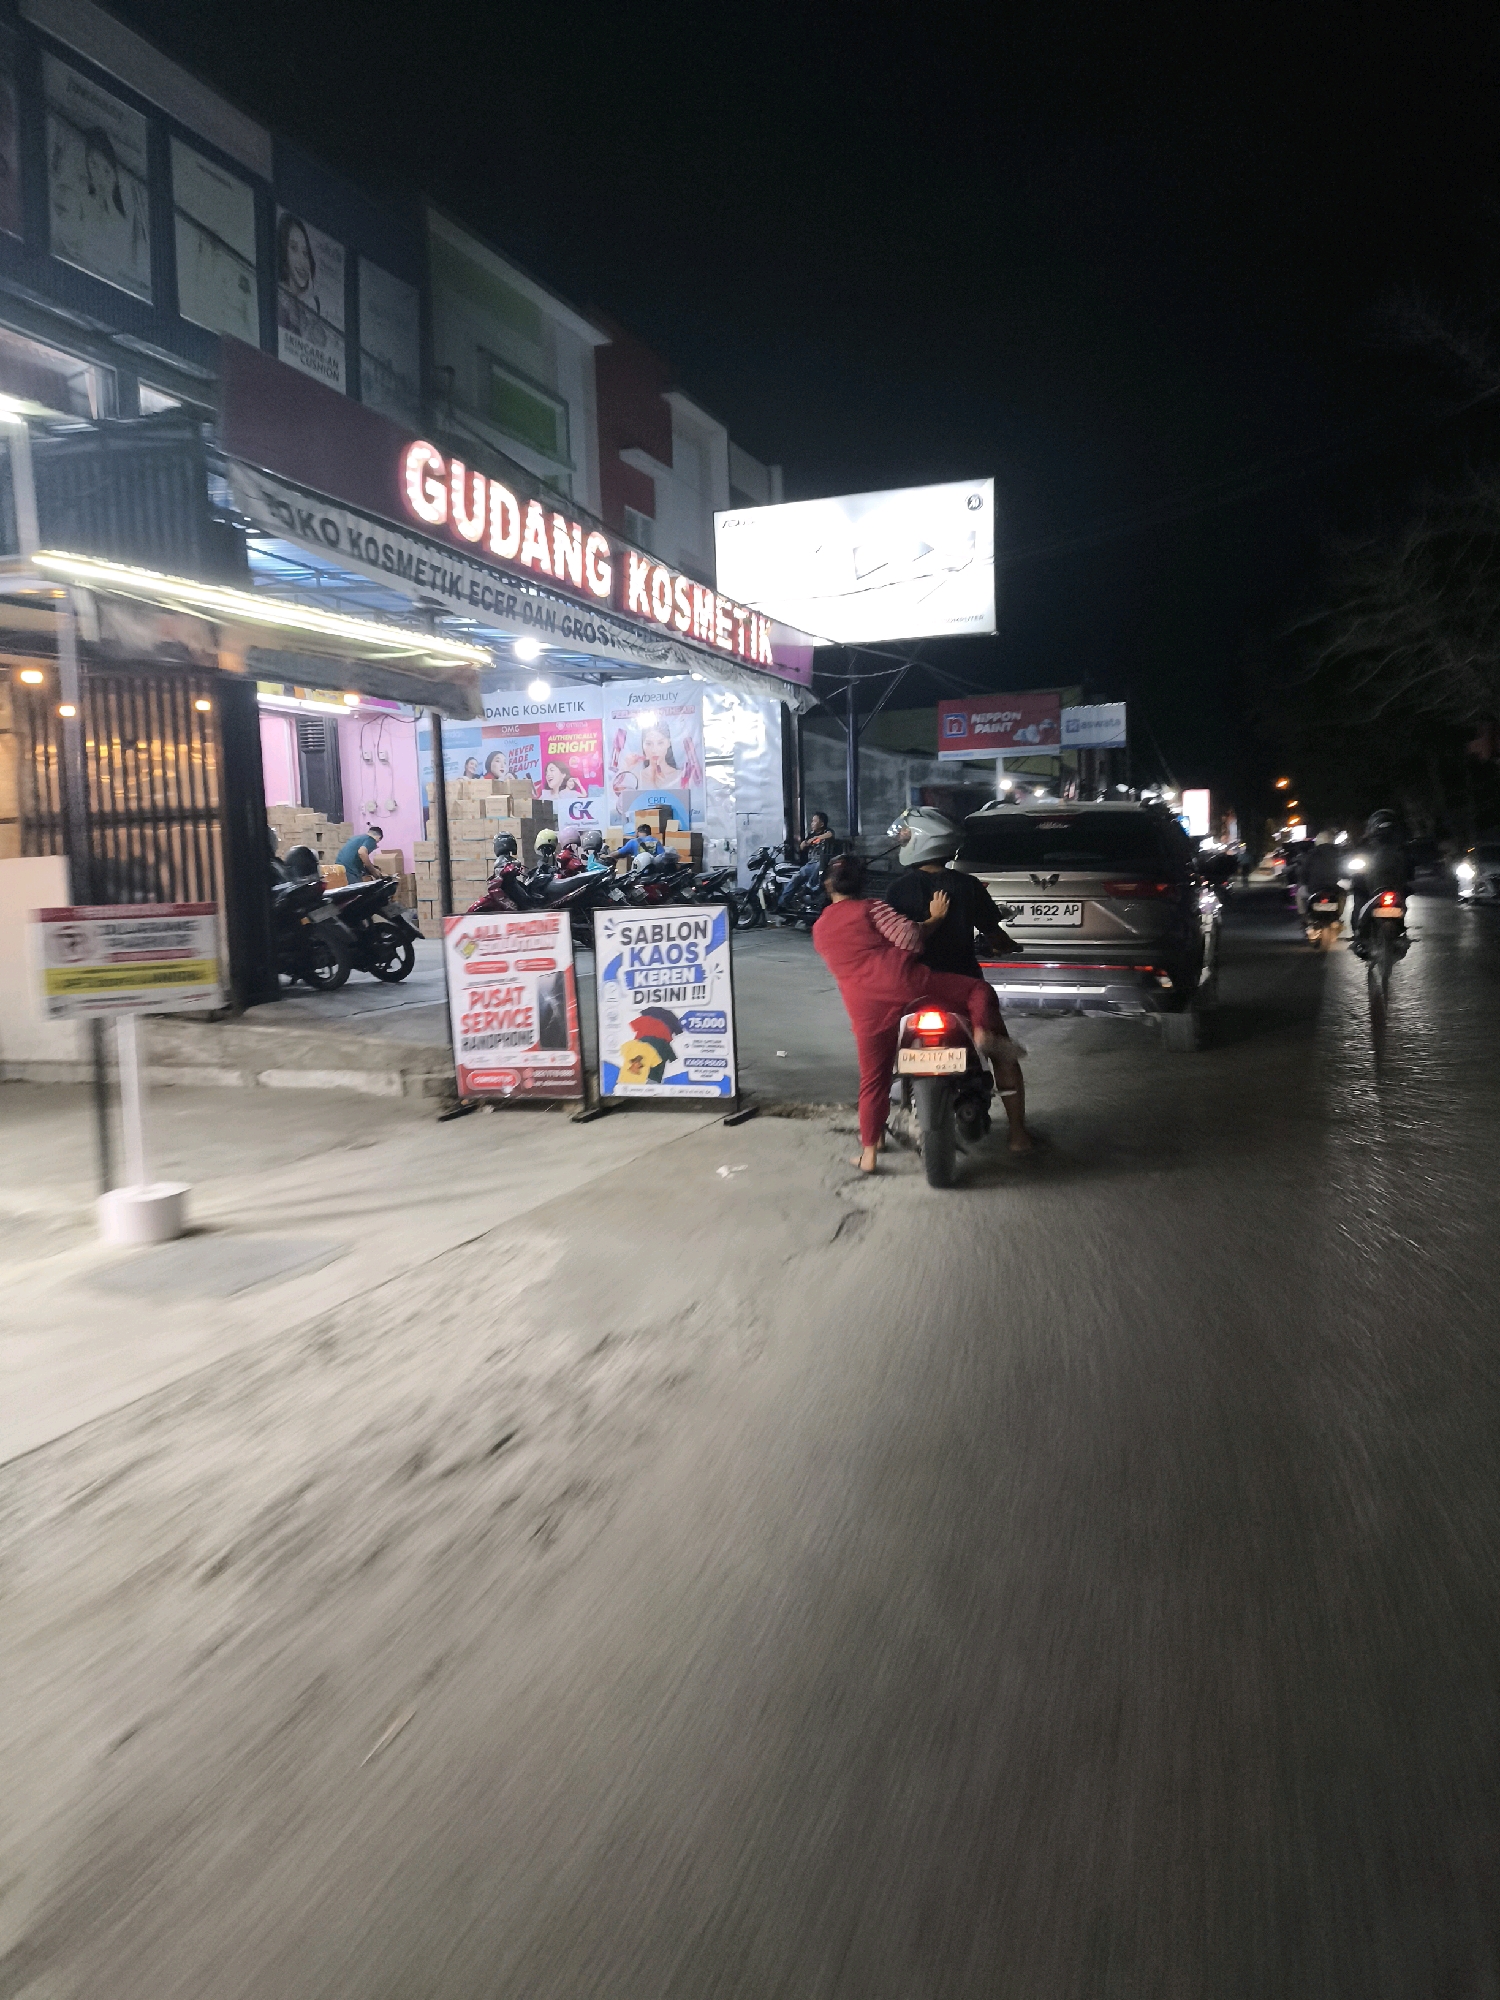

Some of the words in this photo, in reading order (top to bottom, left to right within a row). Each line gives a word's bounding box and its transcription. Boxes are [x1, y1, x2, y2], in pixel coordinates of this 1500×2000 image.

[403, 440, 612, 598] GUDANG
[626, 550, 774, 666] KOSMETIK
[264, 492, 341, 549] OKO
[347, 527, 462, 601] KOSMETIK
[468, 579, 518, 620] ECER
[522, 600, 557, 634] DAN
[627, 692, 679, 706] favbeauty
[486, 706, 519, 719] DANG
[523, 701, 586, 716] KOSMETIK
[970, 711, 1022, 725] NIPPON
[974, 721, 1014, 735] PAINT
[547, 733, 598, 742] AUTHENTICALLY
[508, 744, 535, 757] NEVER
[547, 740, 598, 755] BRIGHT
[508, 759, 540, 774] BEAUTY
[509, 754, 529, 766] FADE
[1030, 904, 1059, 916] 1622
[1063, 904, 1080, 916] AP
[506, 919, 560, 935] PHONE
[620, 919, 708, 946] SABLON
[630, 942, 699, 968] KAOS
[634, 967, 696, 988] KEREN
[468, 986, 526, 1010] PUSAT
[633, 986, 687, 1005] DISINI
[461, 1006, 533, 1035] SERVICE
[461, 1029, 534, 1051] HANDPHONE
[920, 1052, 943, 1062] 2117
